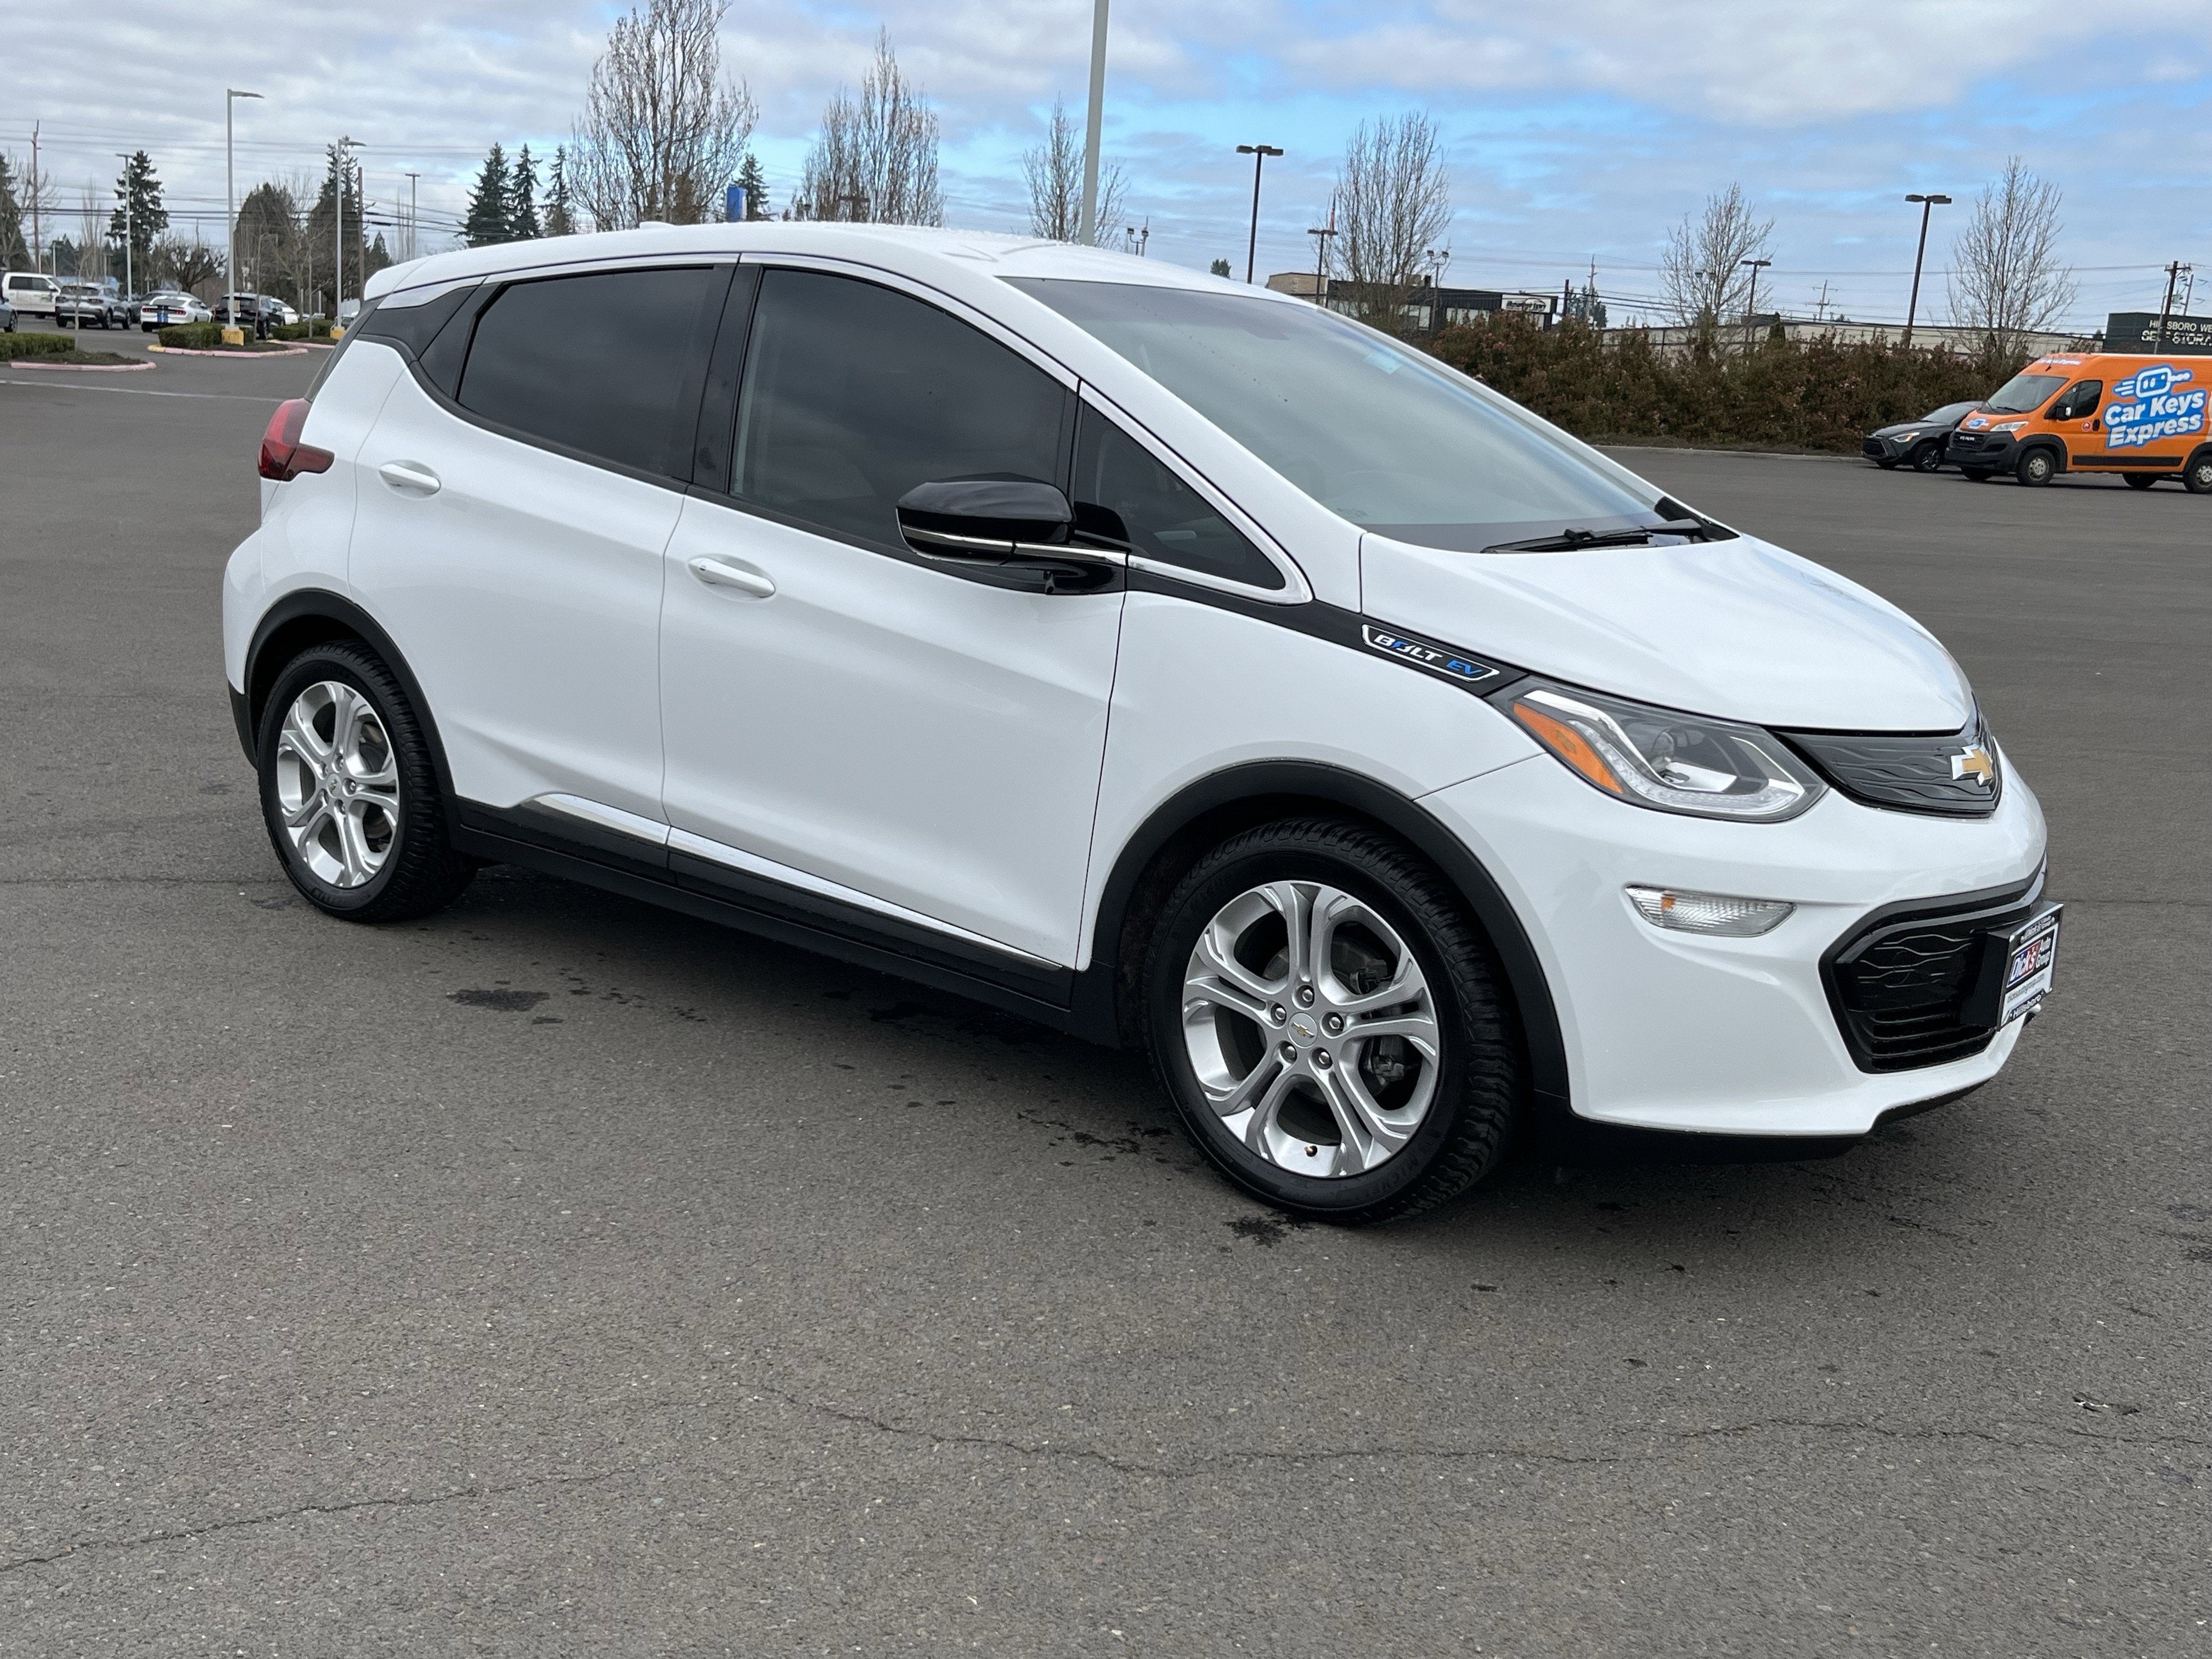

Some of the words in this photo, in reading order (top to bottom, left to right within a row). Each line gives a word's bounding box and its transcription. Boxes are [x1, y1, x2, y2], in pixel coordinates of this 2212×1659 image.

[2149, 319, 2197, 332] HISBORO
[2105, 404, 2146, 426] Car
[2149, 392, 2204, 417] Keys
[2109, 414, 2202, 447] Express
[1374, 634, 1443, 661] BOLT
[1446, 659, 1483, 675] EV
[2010, 946, 2036, 982] Dick's
